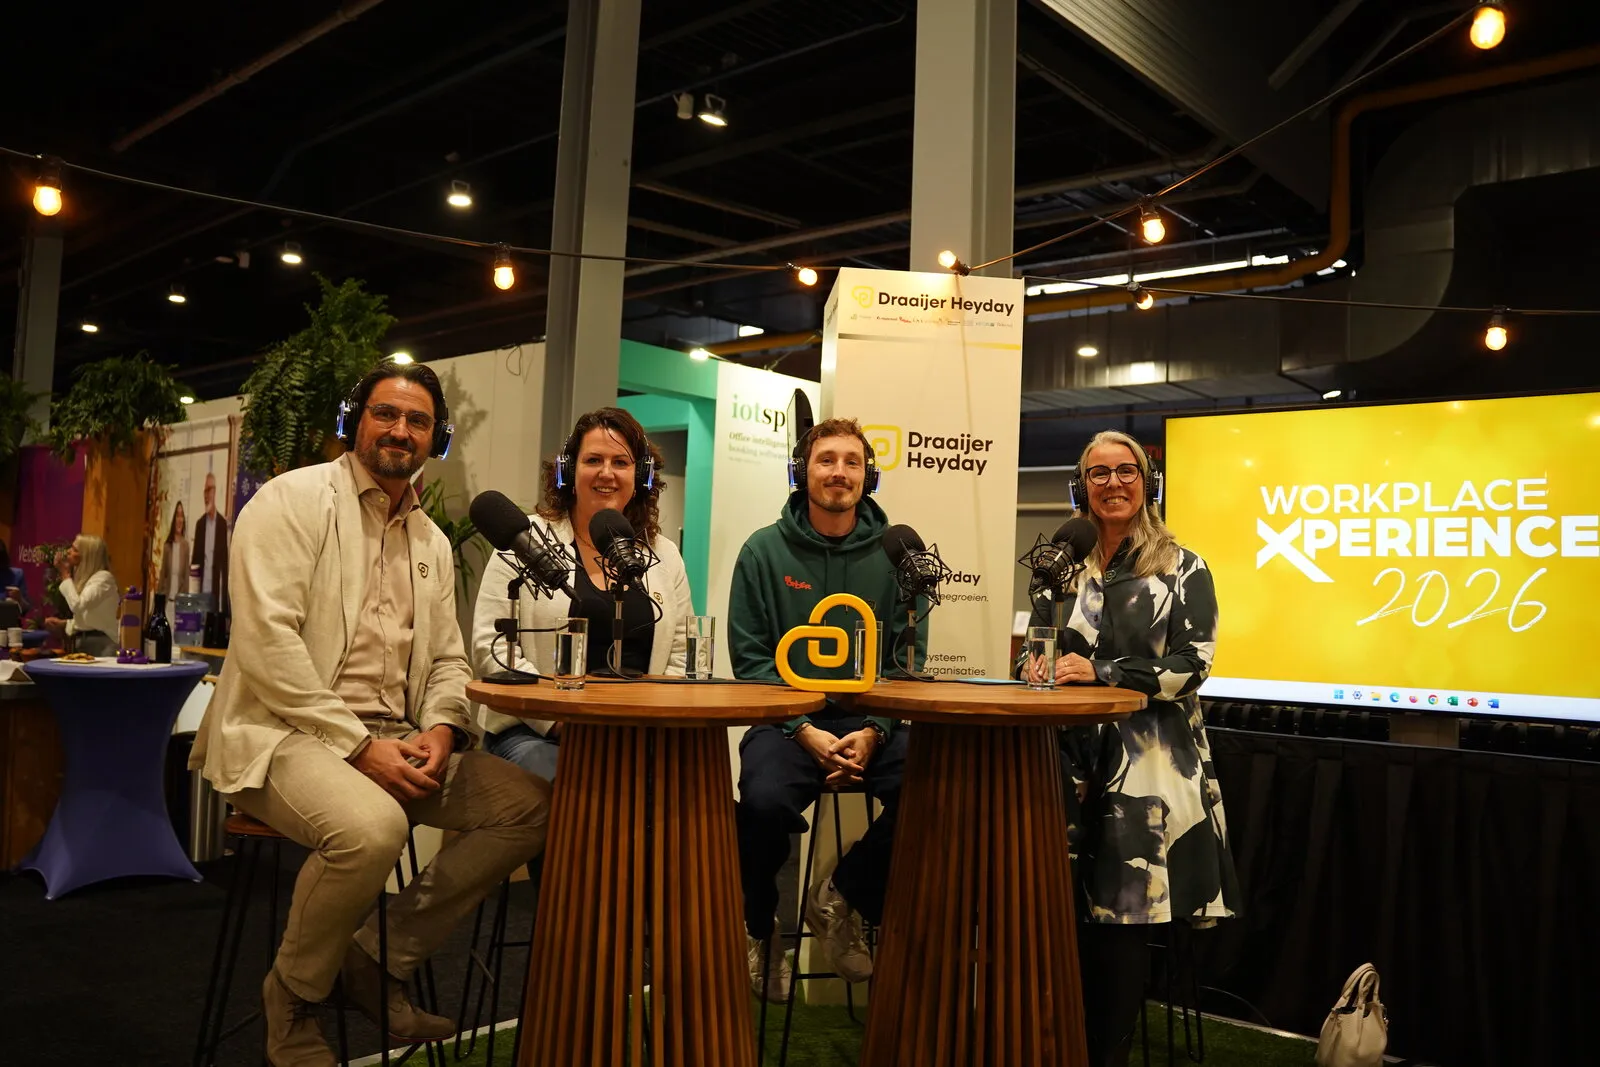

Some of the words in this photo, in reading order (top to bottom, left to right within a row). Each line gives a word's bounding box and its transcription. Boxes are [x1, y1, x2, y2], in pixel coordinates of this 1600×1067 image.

[878, 292, 946, 311] Draaijer
[951, 297, 1015, 316] Heyday
[731, 394, 786, 433] iotsp
[908, 431, 993, 455] Draaijer
[907, 452, 988, 476] Heyday
[1259, 478, 1548, 515] WORKPLACE
[1256, 515, 1600, 583] XPERIENCE
[944, 570, 981, 586] yday
[939, 593, 989, 603] eegroeien.
[1356, 567, 1547, 632] 2026
[923, 666, 986, 677] organisaties
